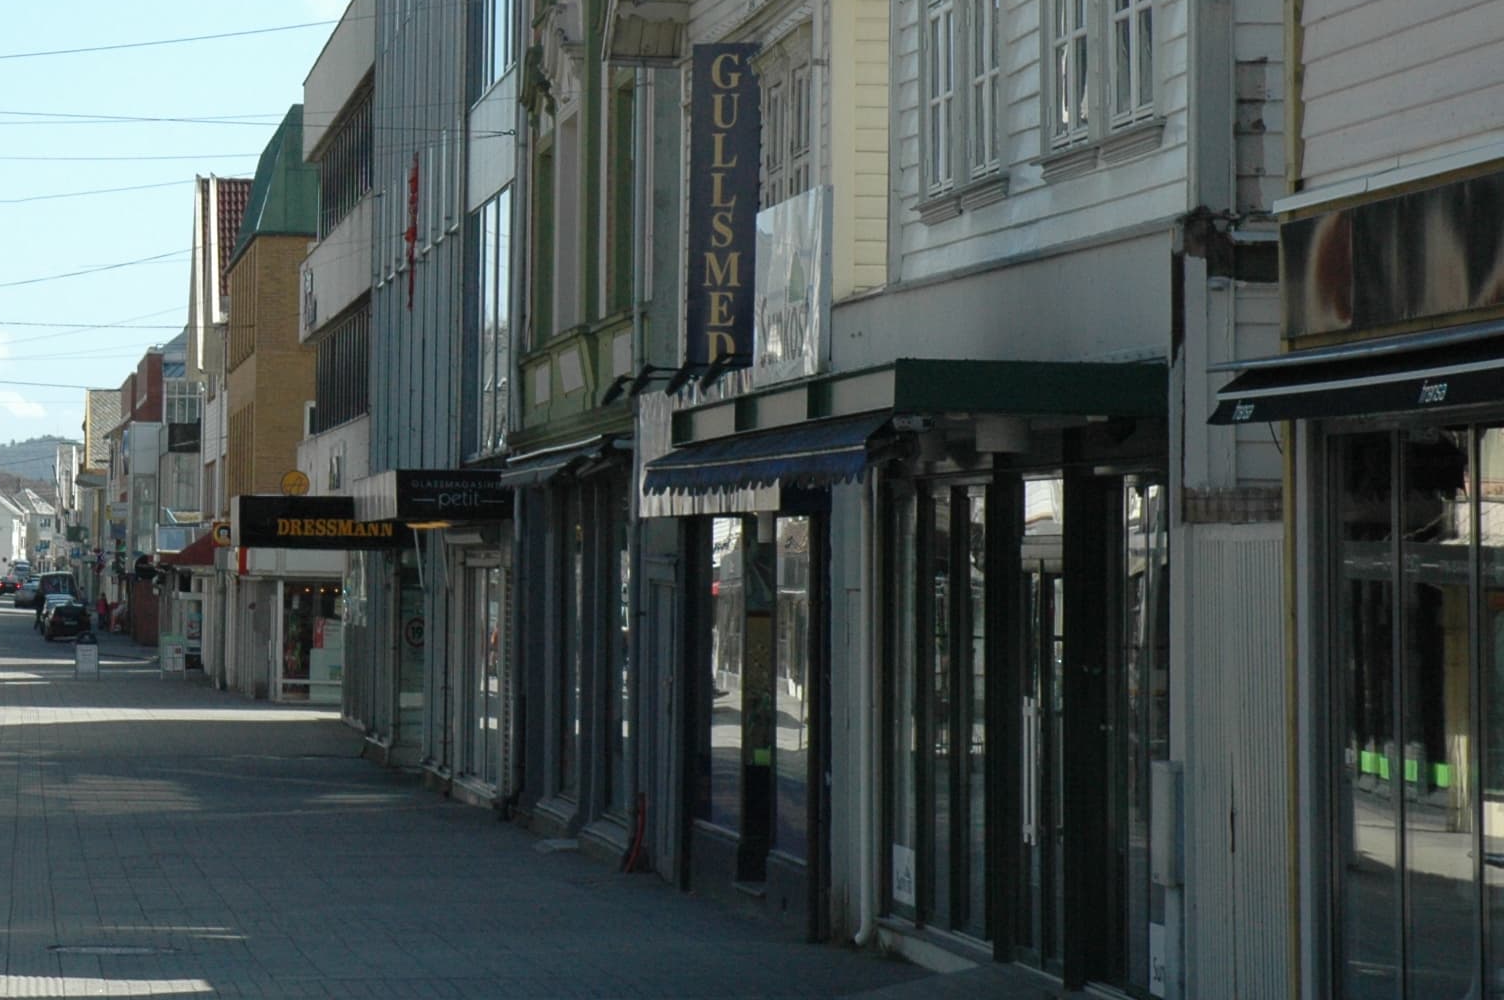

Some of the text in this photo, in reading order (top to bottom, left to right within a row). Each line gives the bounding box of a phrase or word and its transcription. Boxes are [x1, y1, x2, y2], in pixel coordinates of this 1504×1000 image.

[703, 53, 742, 365] GULLSMED
[438, 488, 481, 510] petit
[276, 518, 394, 537] DRESSMANN
